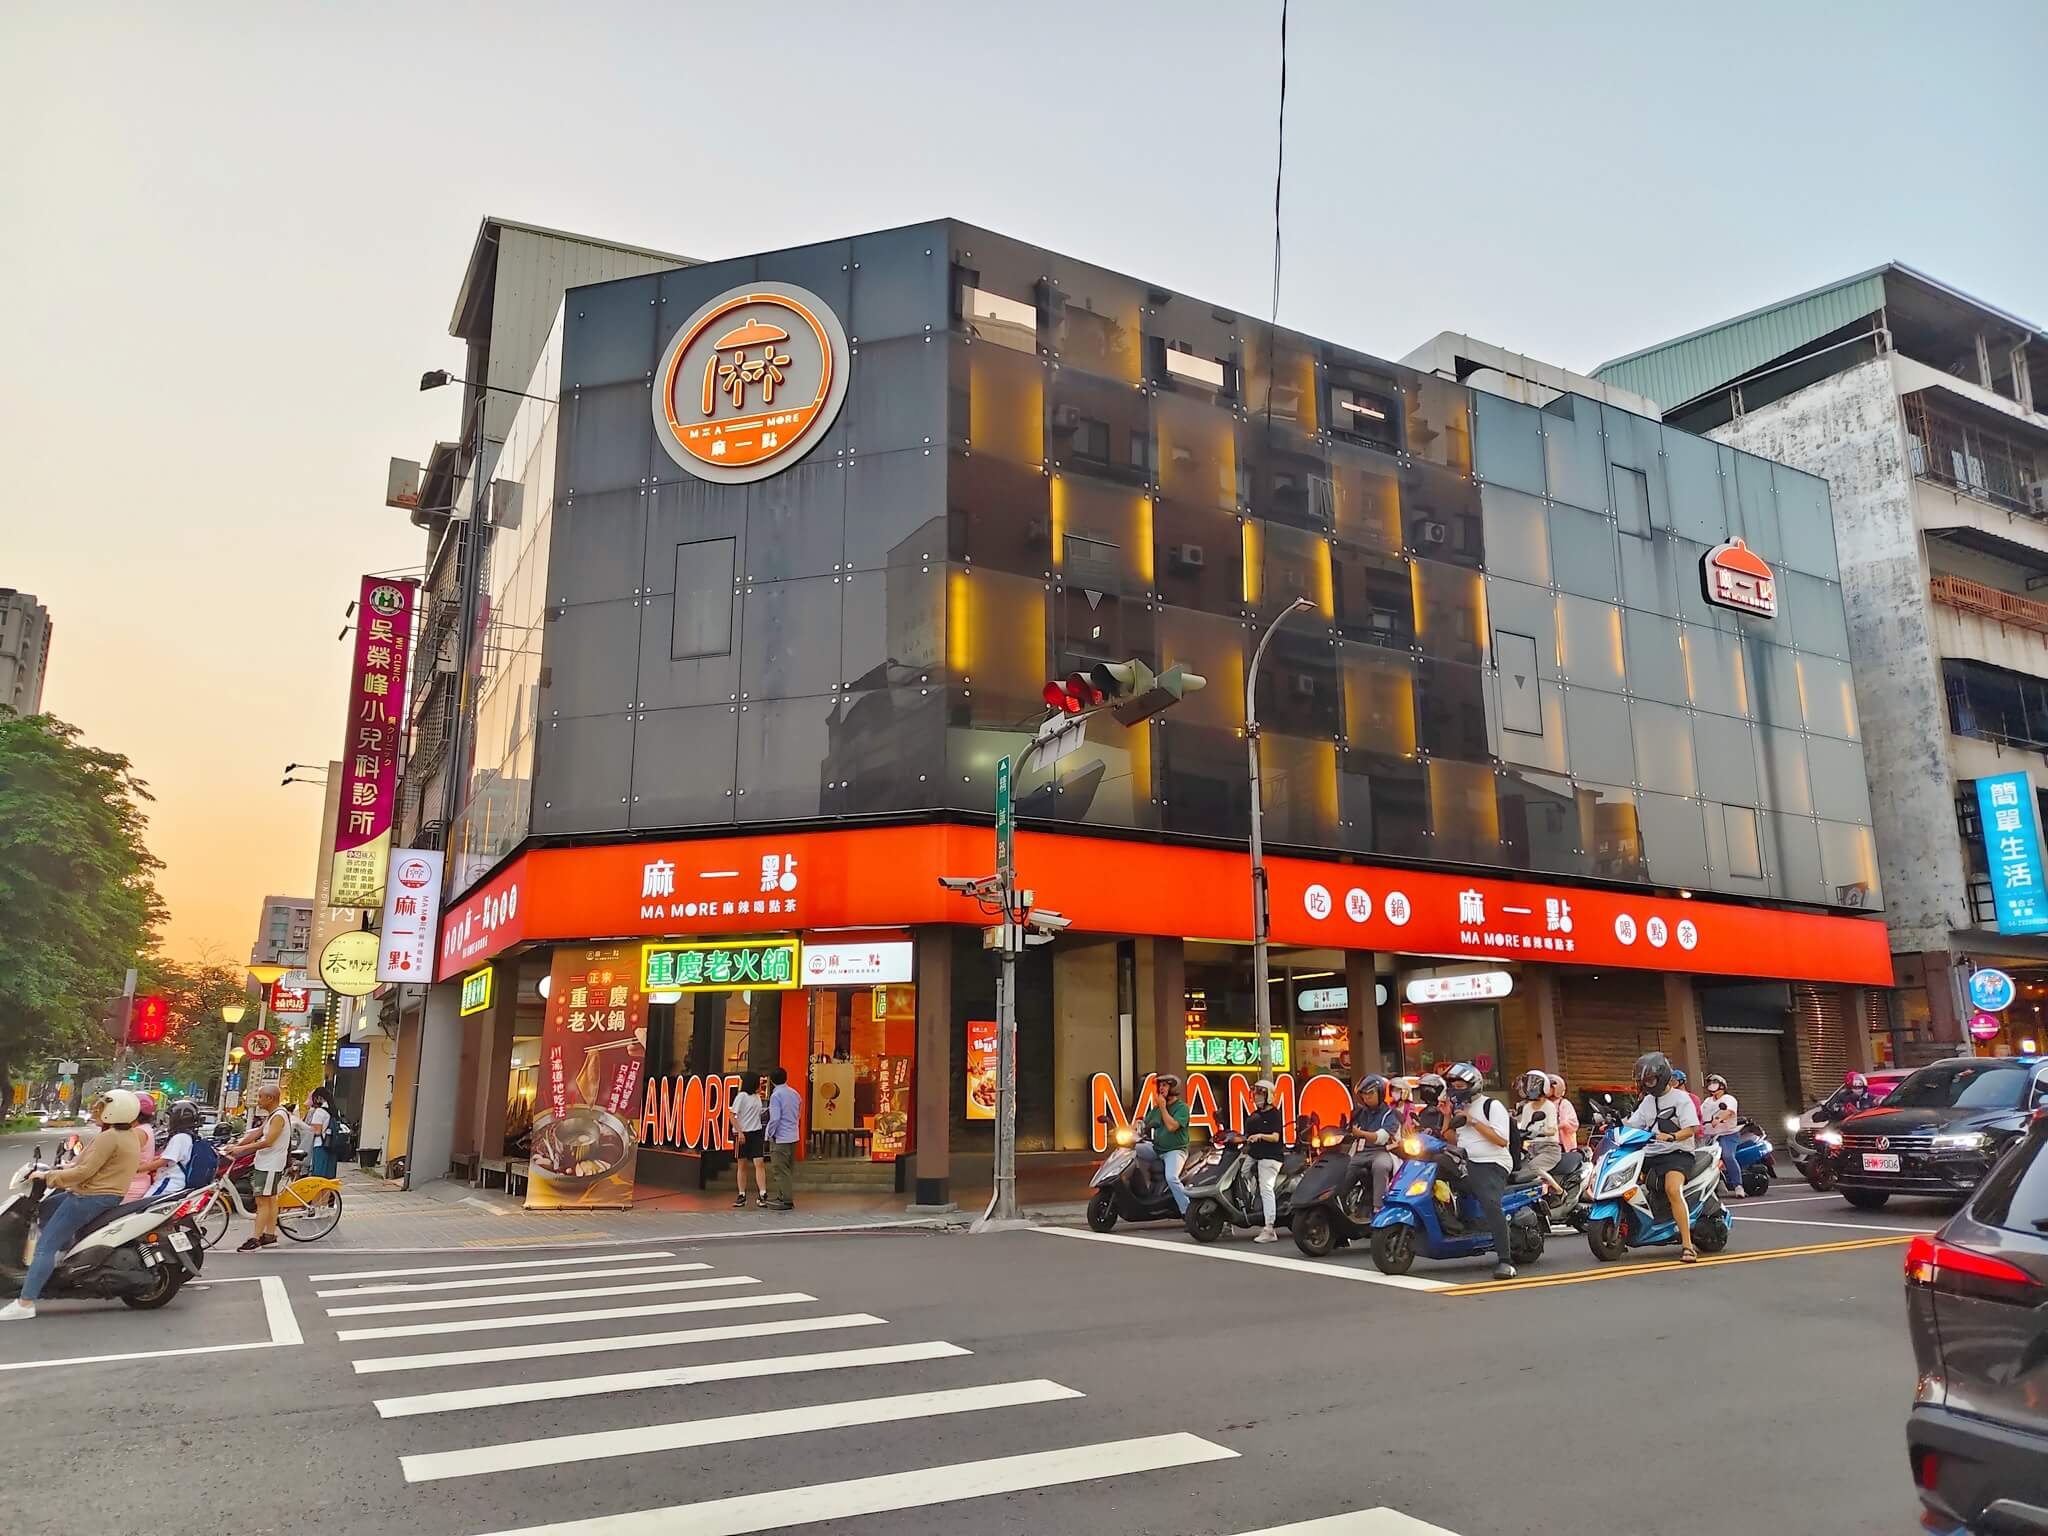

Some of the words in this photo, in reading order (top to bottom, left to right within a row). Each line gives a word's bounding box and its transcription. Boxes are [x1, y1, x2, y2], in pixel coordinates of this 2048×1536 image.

[767, 413, 800, 427] MORE
[711, 432, 778, 457] 麻一點
[395, 637, 404, 650] WU
[392, 653, 403, 683] CLINIC
[1990, 782, 2033, 889] 簡單生活
[641, 853, 798, 898] 麻一點
[640, 905, 665, 919] MA
[670, 902, 718, 918] MORE
[722, 899, 798, 915] 麻辣喝點茶
[1459, 888, 1573, 933] 麻一點
[388, 895, 418, 971] 麻一點
[1460, 930, 1480, 944] MA
[1483, 932, 1520, 948] MORE
[647, 948, 790, 985] 重慶老火鍋
[828, 952, 881, 967] 麻一點
[589, 971, 613, 984] 正宗
[567, 1010, 626, 1032] 老火鍋
[638, 1074, 742, 1151] AMORE
